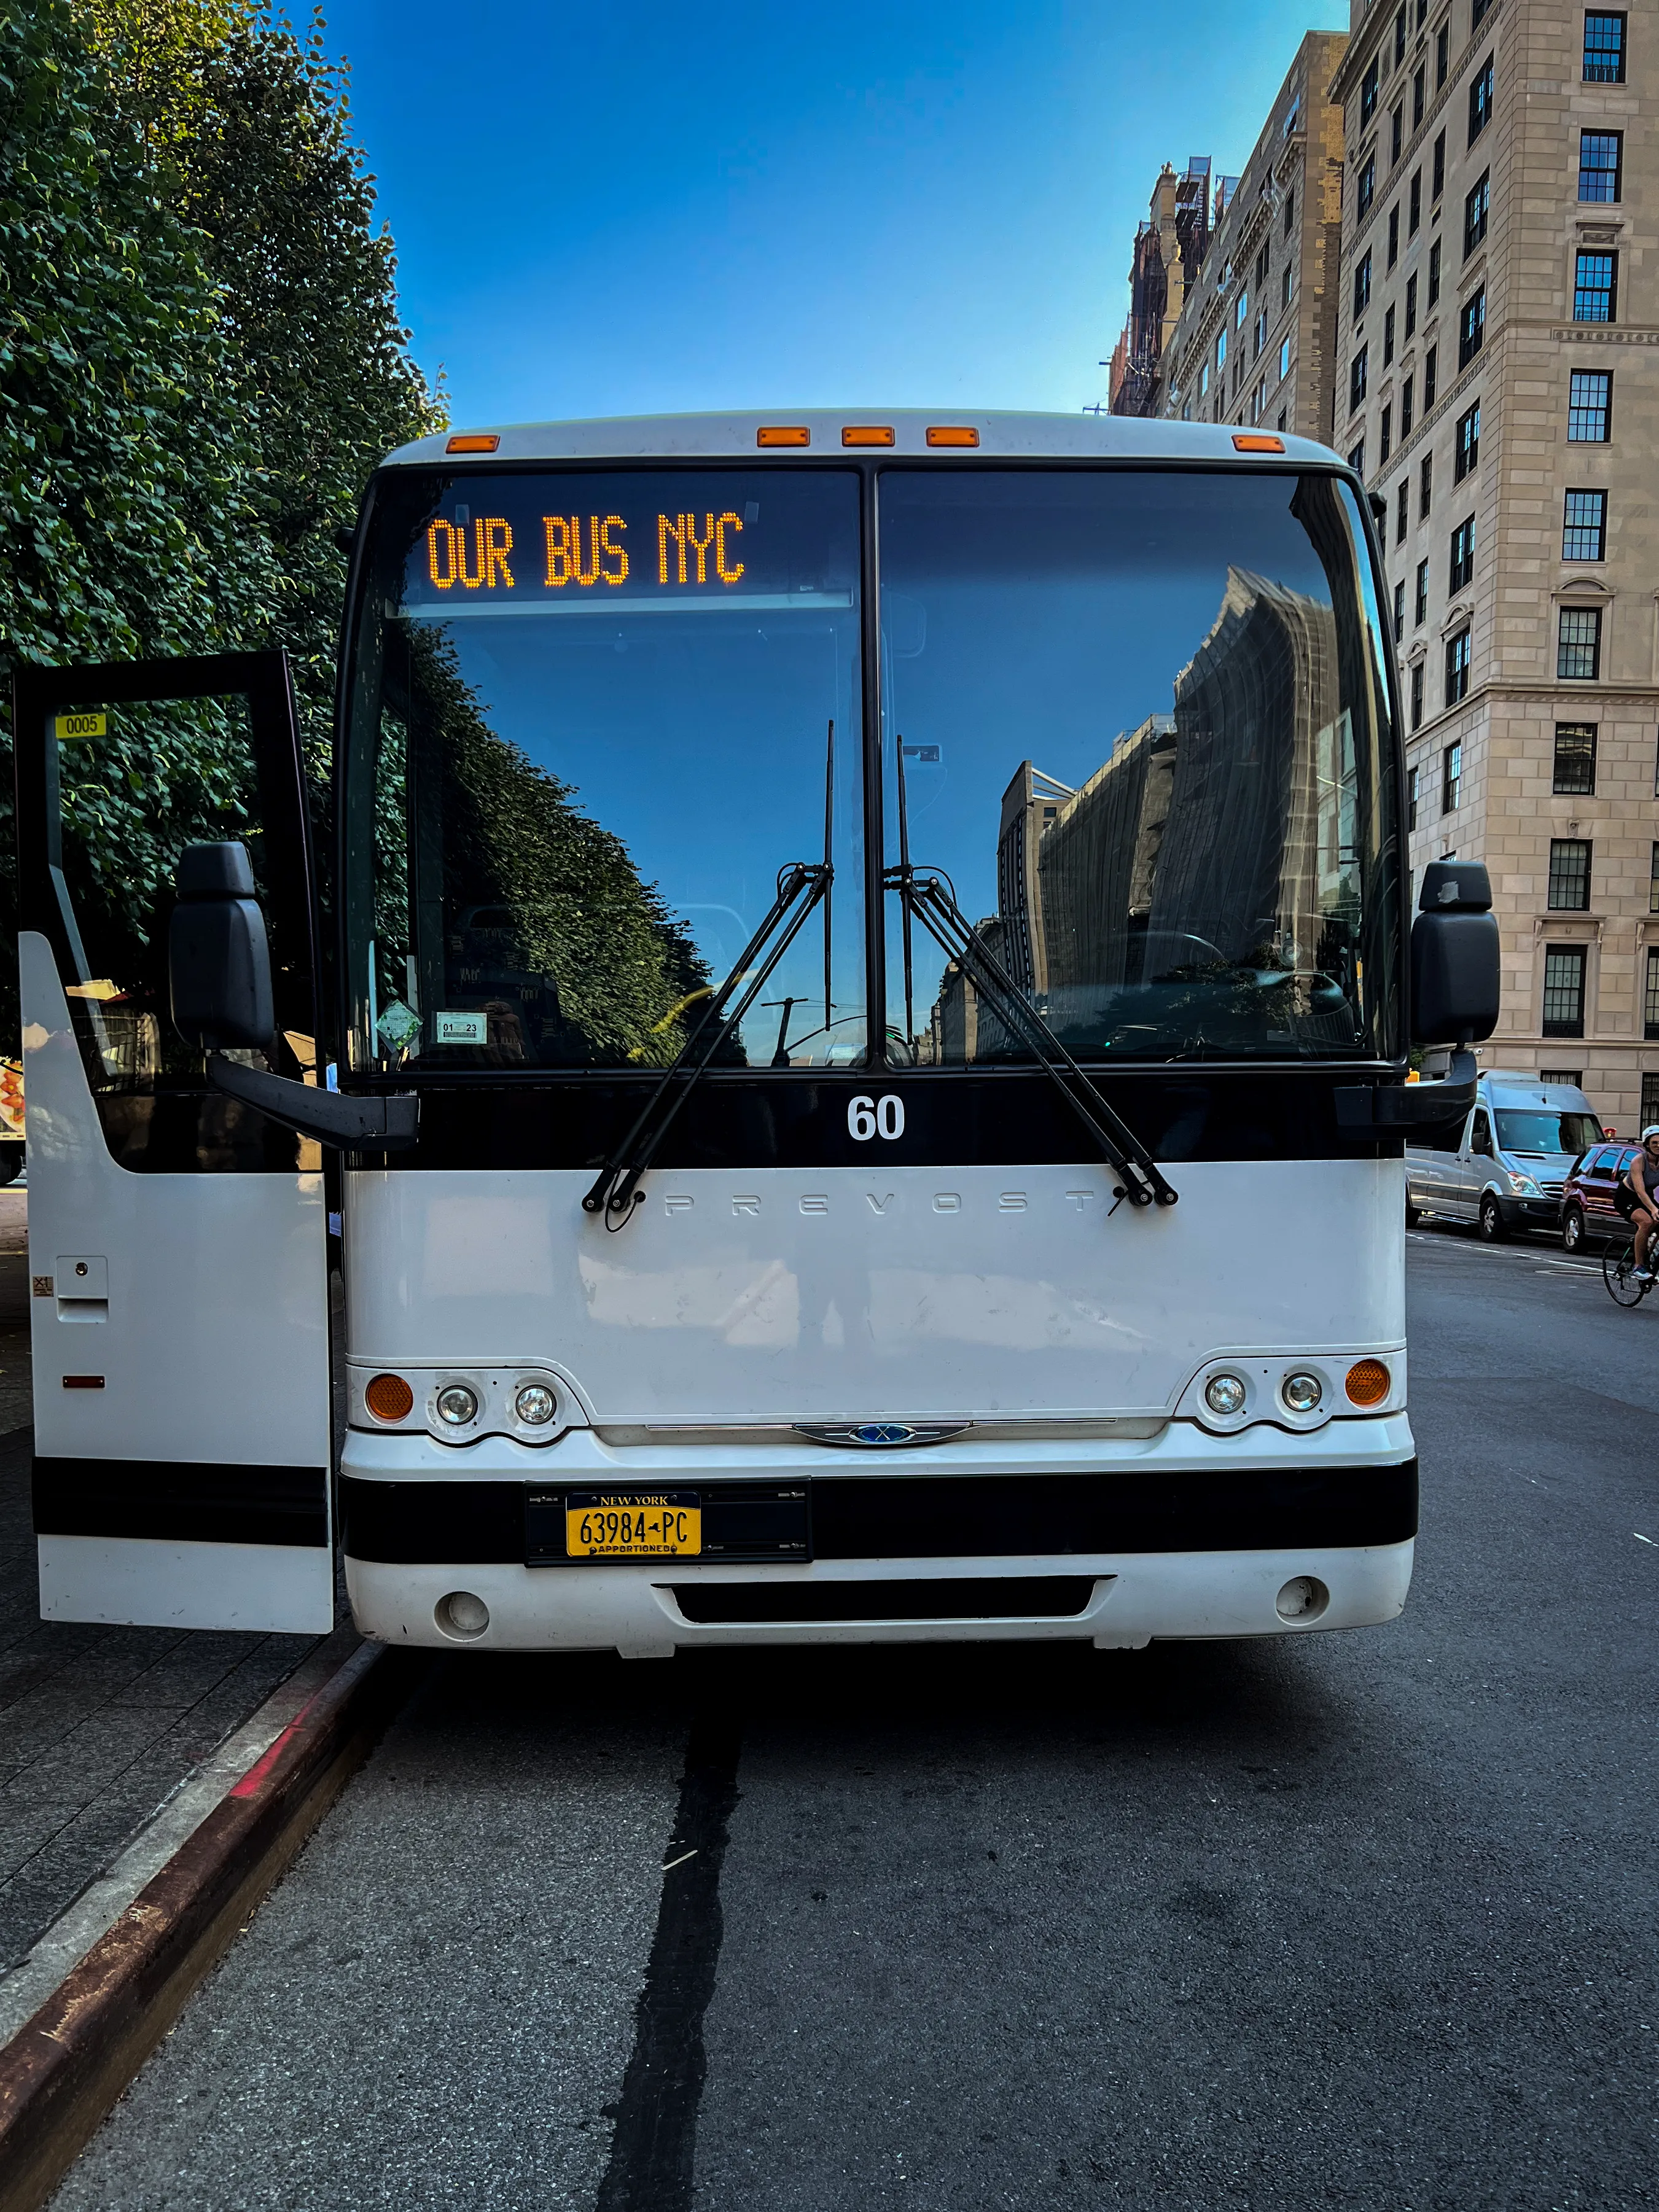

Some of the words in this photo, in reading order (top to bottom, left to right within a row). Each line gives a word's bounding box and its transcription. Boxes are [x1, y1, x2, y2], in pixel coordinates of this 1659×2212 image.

[427, 518, 515, 588] OUR
[542, 515, 630, 586] BUS
[658, 512, 744, 584] NYC
[66, 716, 98, 734] 0005
[848, 1094, 905, 1140] 60
[665, 1191, 1094, 1216] PREVOST
[601, 1497, 631, 1506] NEW
[598, 1544, 670, 1553] APPORTIONED
